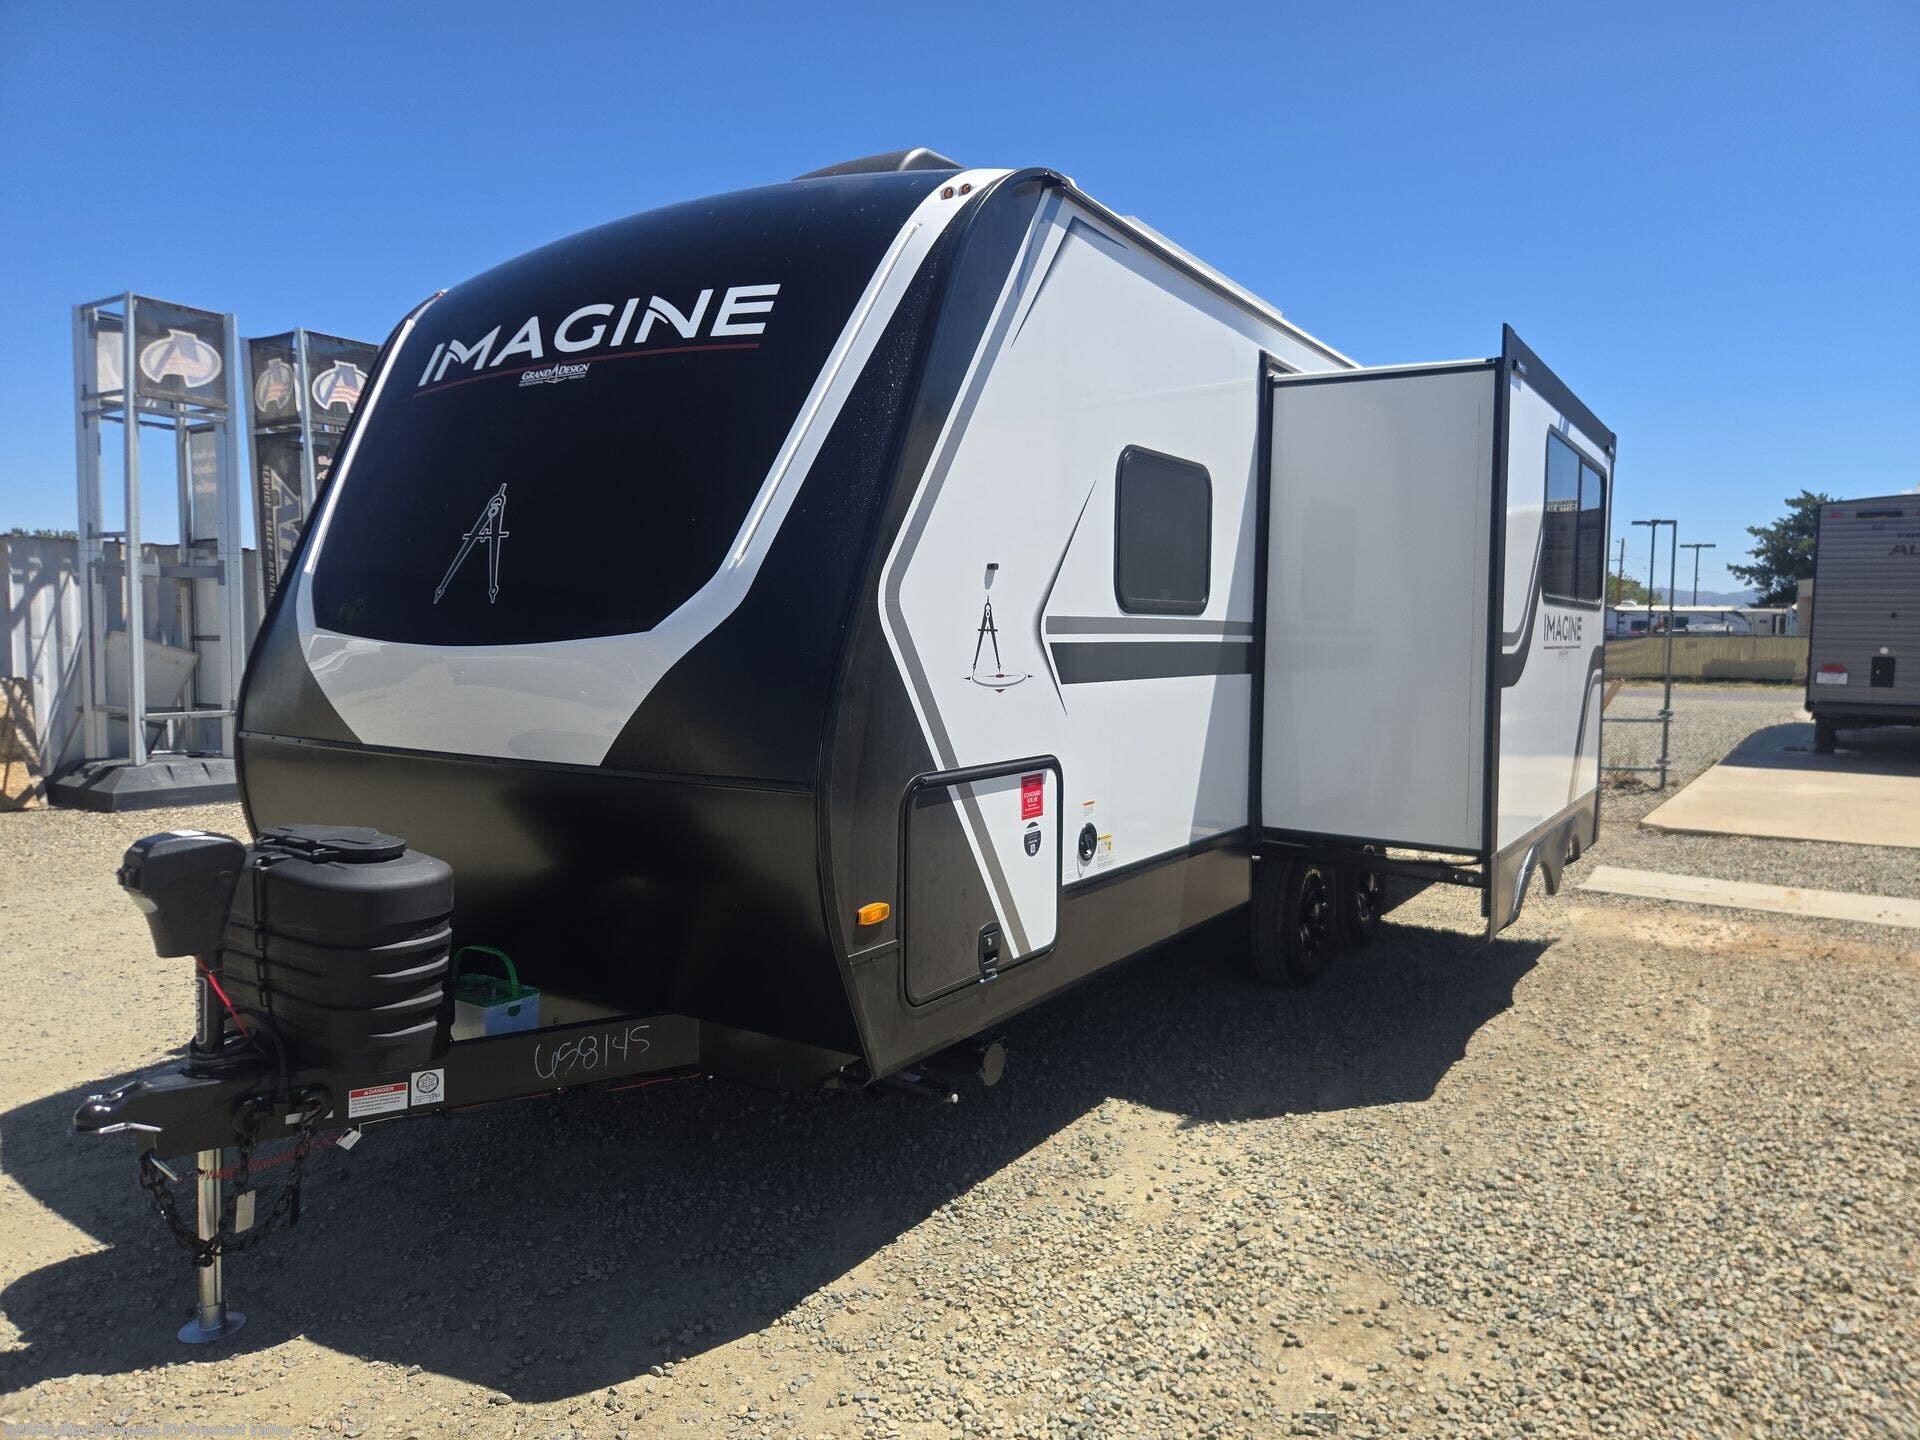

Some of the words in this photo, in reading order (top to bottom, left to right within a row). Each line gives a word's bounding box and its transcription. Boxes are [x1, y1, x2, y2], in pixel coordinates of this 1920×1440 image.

[418, 283, 781, 387] IMAGINE
[1544, 613, 1582, 641] IMAGINE
[368, 1086, 394, 1095] DANGER
